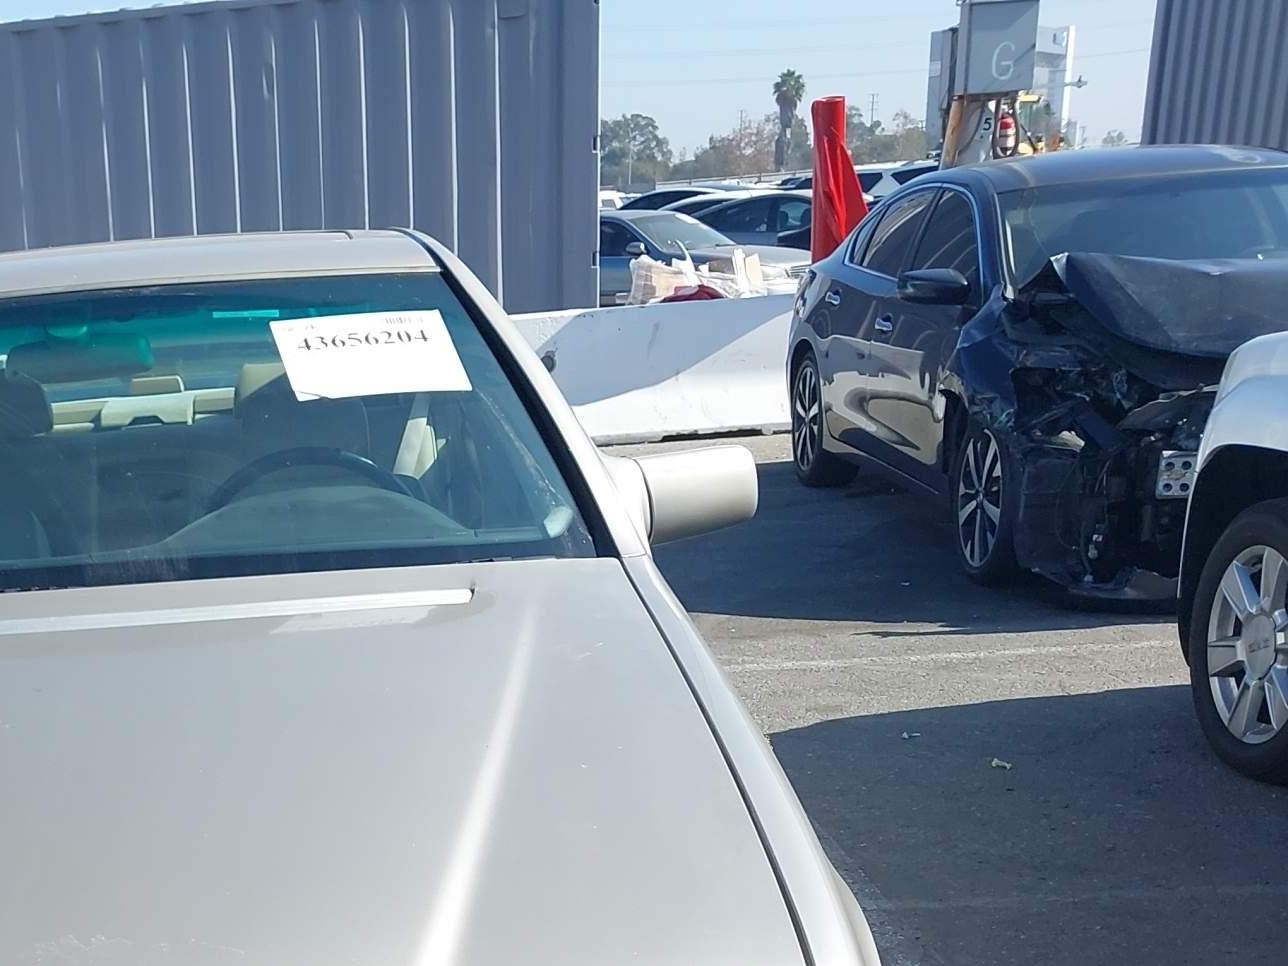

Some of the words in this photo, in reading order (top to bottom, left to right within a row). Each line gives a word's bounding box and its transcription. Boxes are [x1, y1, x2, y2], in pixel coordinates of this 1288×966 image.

[991, 41, 1016, 81] G
[982, 117, 993, 132] 5
[297, 328, 432, 351] 43656204
